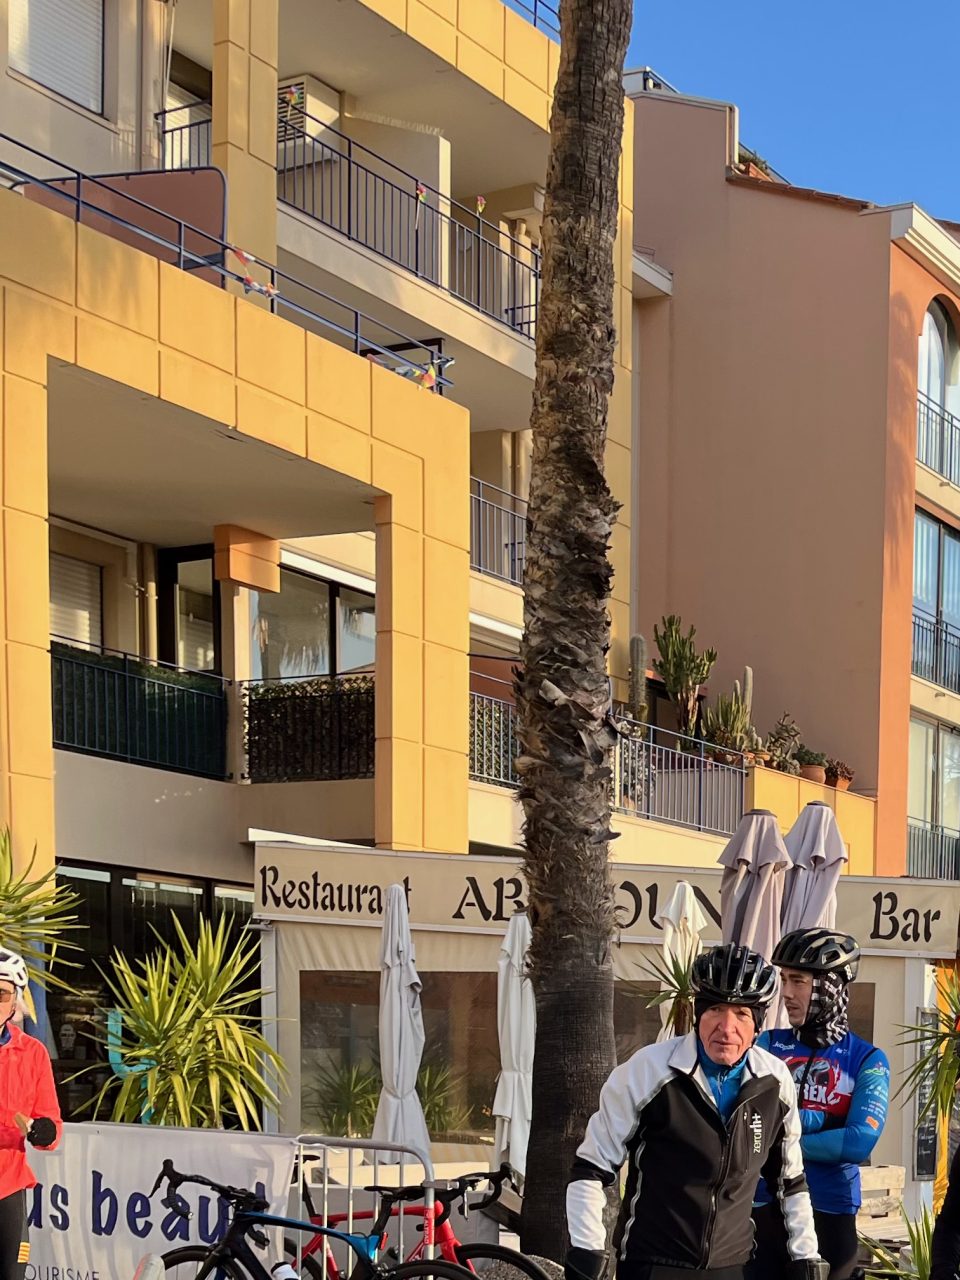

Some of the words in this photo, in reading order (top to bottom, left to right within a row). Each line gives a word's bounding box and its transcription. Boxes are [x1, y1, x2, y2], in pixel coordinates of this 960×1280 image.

[259, 865, 413, 914] Restaurat
[869, 891, 941, 943] Bar
[91, 1170, 267, 1245] beau
